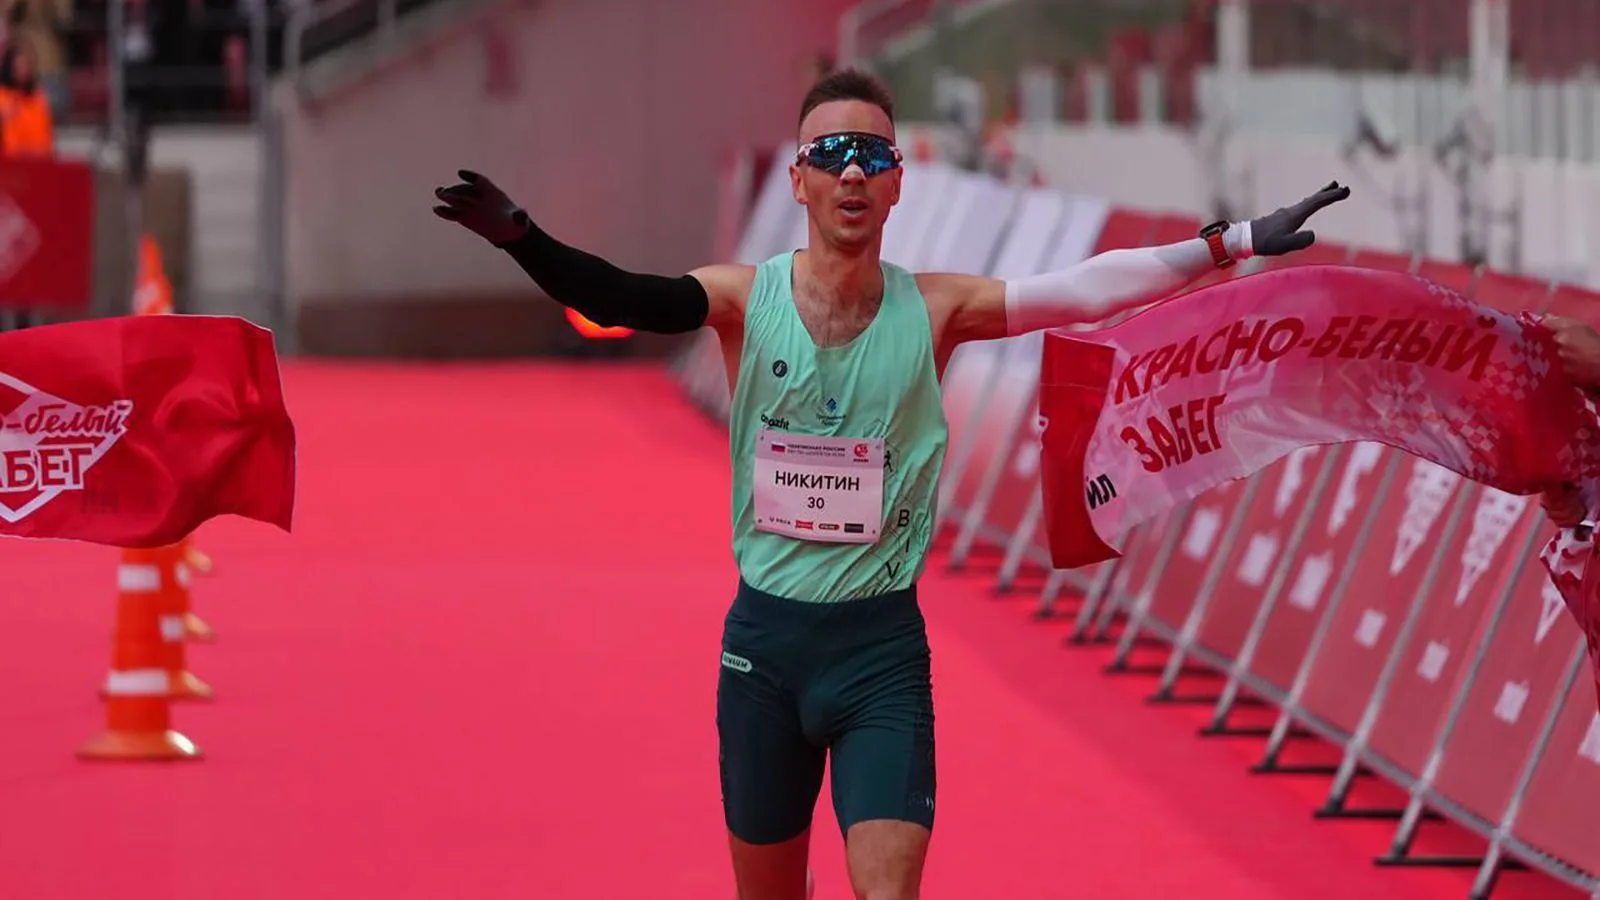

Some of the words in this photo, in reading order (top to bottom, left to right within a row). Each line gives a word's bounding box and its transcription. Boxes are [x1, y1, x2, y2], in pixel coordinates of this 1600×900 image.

[1114, 315, 1499, 405] КРАСНО-БЕЛЫЙ
[0, 403, 131, 435] -белый
[1120, 393, 1227, 473] ЗАБЕГ
[0, 447, 93, 488] БЕГ
[775, 470, 860, 491] НИКИТИН
[807, 496, 825, 509] 30
